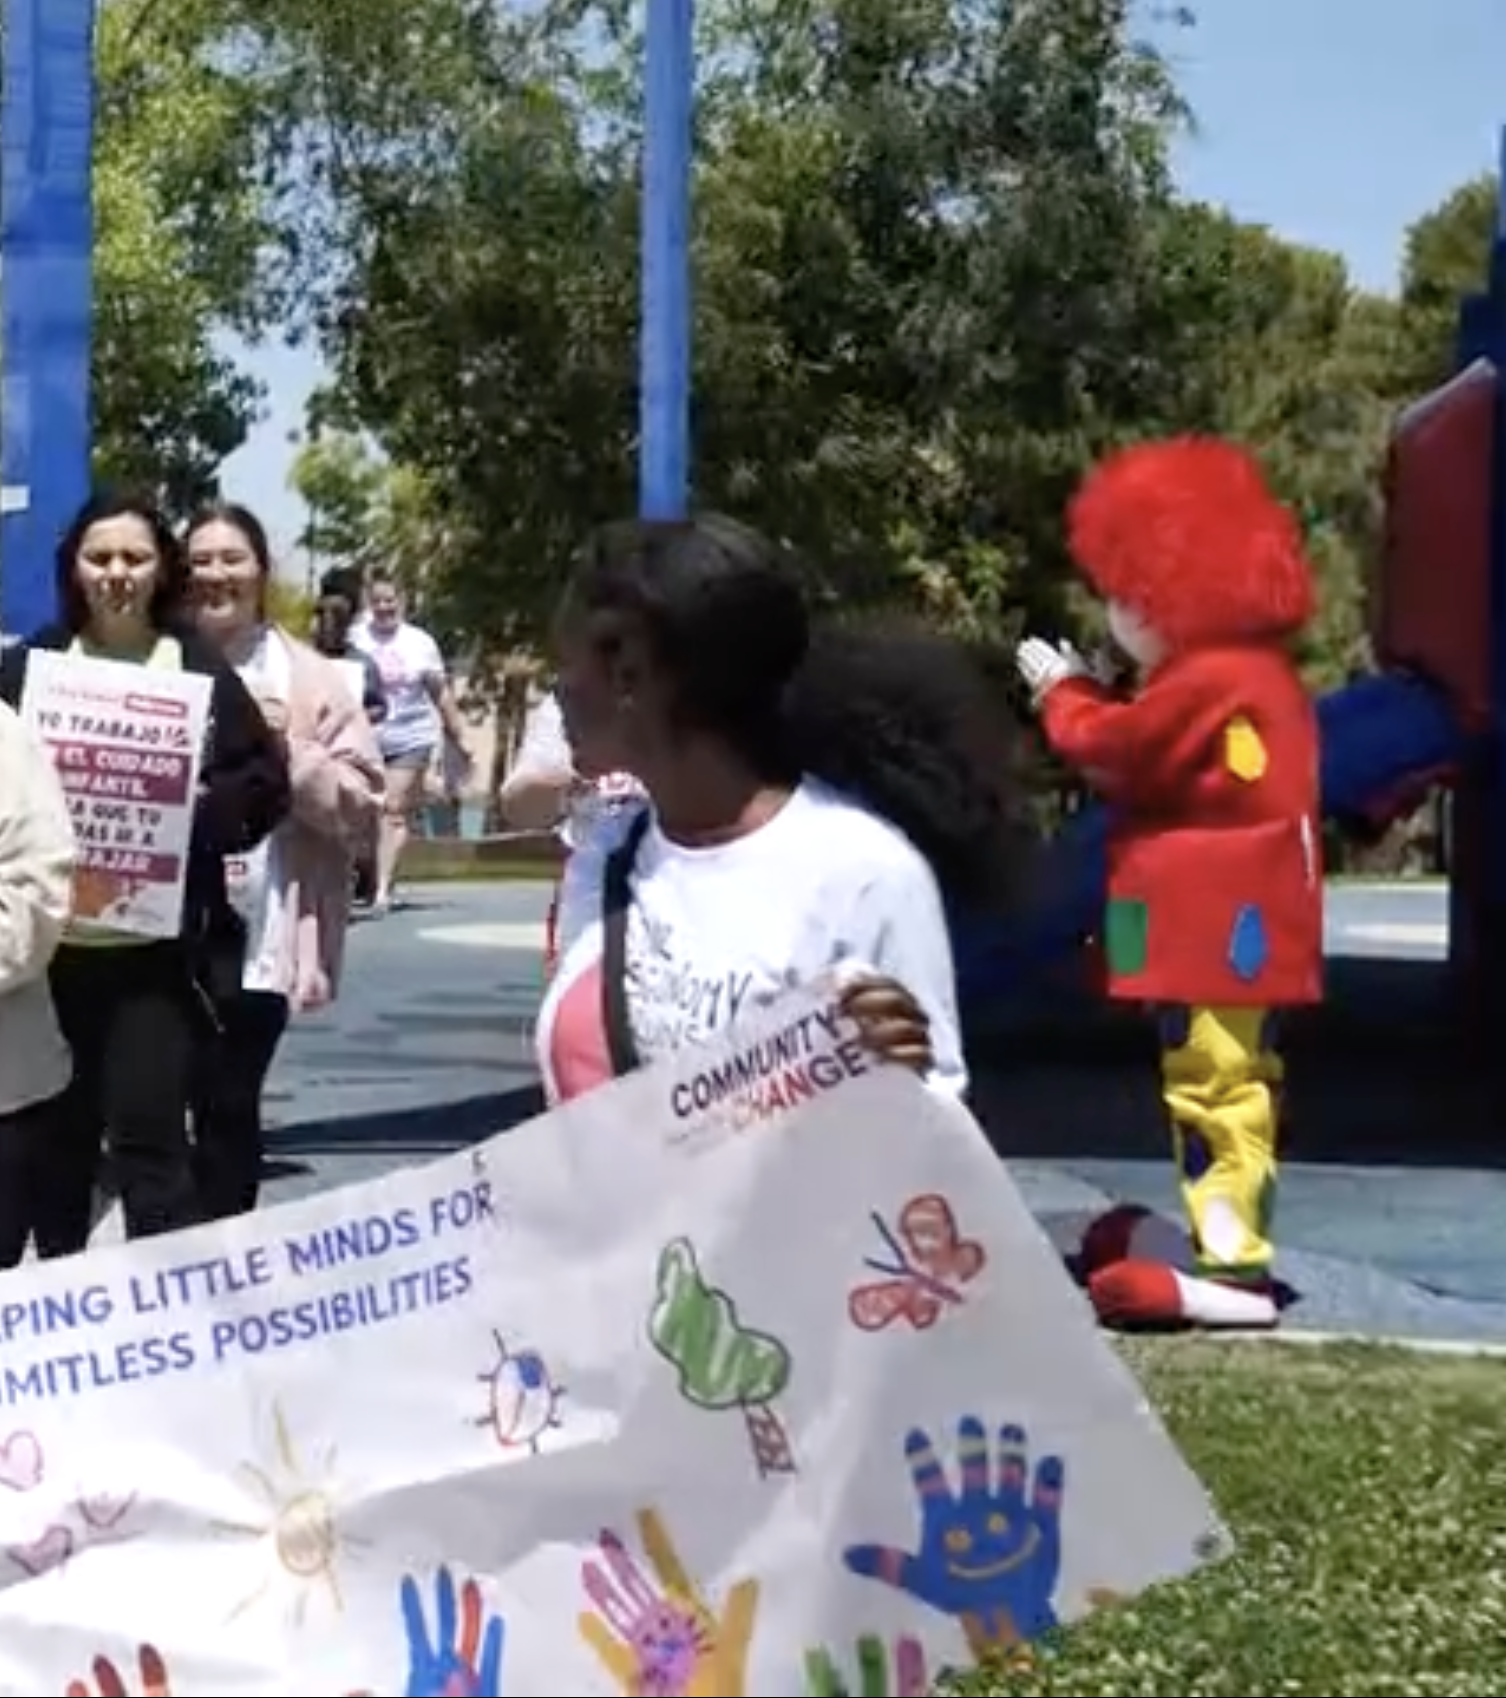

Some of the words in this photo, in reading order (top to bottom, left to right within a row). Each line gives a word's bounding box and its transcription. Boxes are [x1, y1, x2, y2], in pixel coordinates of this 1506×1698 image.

[69, 714, 161, 744] TRABAJO
[62, 772, 149, 797] NFANTIL
[97, 752, 181, 778] CUIDADO
[671, 999, 844, 1118] COMMUNITY
[127, 1246, 273, 1313] LITTLE
[285, 1208, 420, 1278] MINDS
[430, 1180, 496, 1241] FOR
[212, 1256, 473, 1361] POSSIBILITIES
